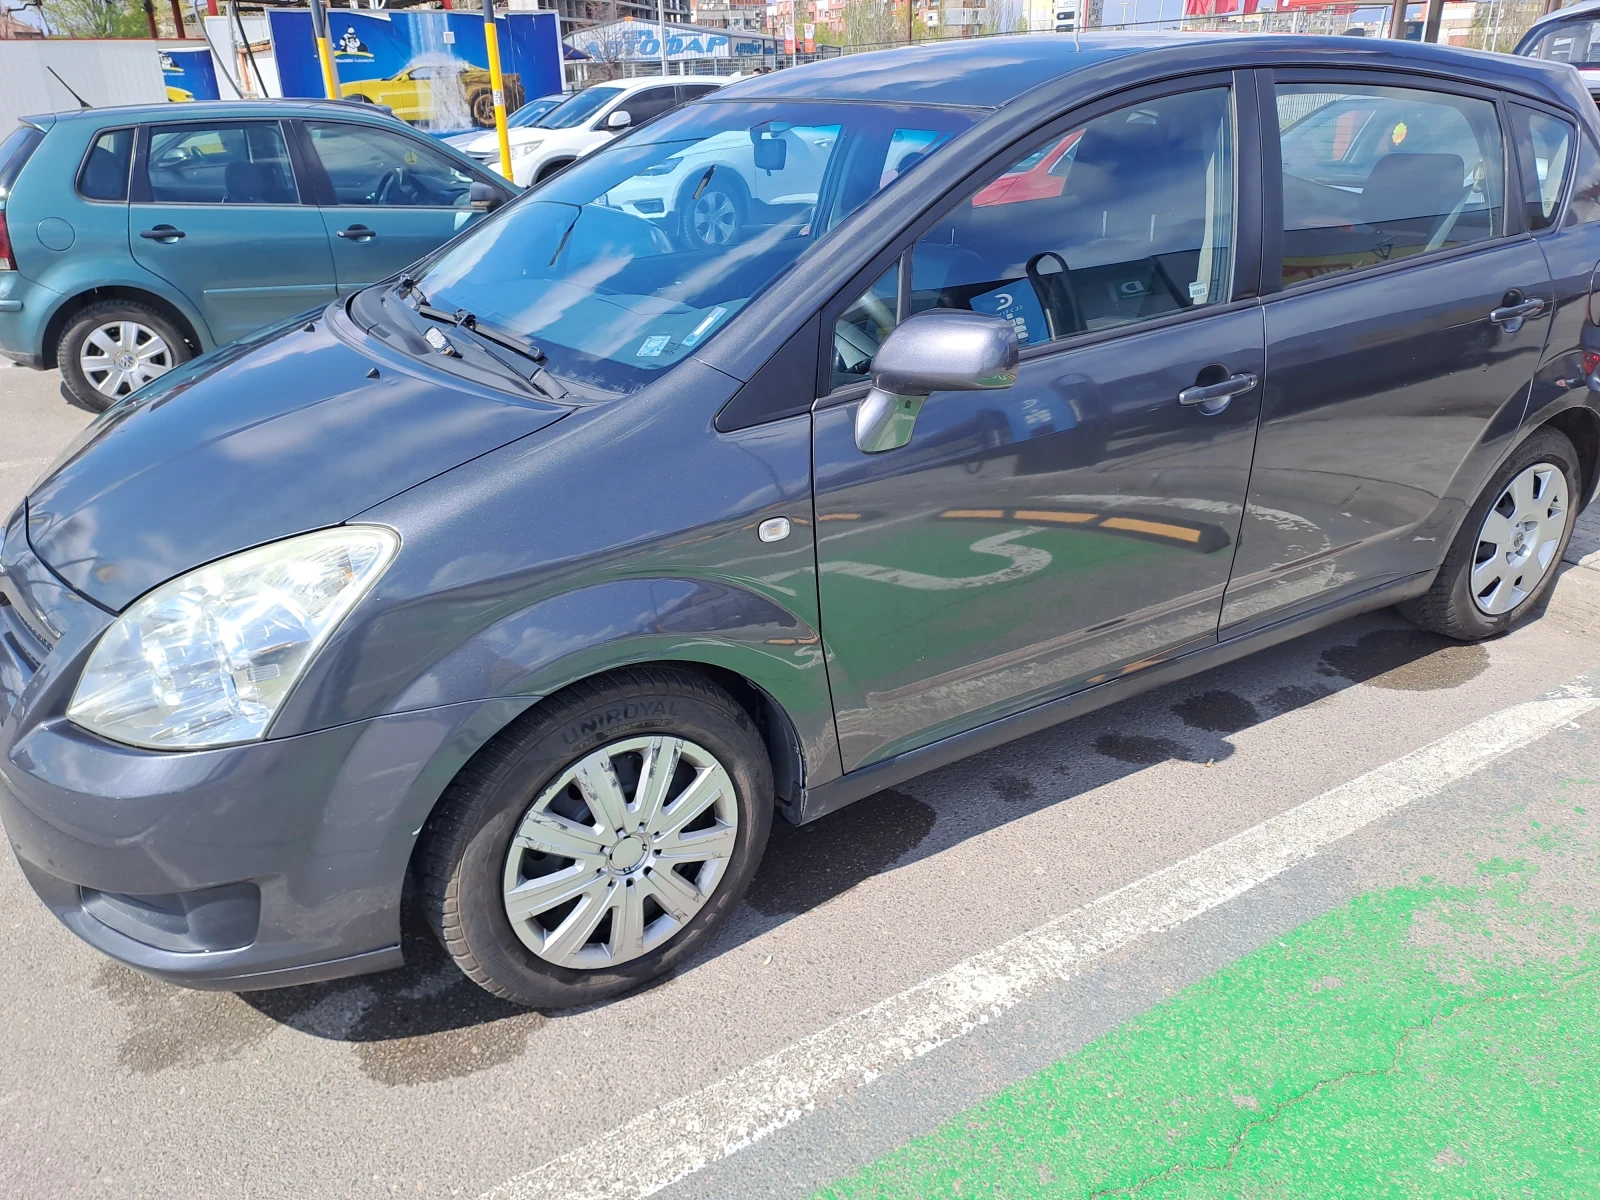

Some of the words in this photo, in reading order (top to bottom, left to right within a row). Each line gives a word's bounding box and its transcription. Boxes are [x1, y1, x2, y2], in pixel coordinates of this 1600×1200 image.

[622, 29, 671, 40] СЕРВЗ
[561, 701, 681, 745] UNIROYAL
[639, 719, 670, 728] TYRE
